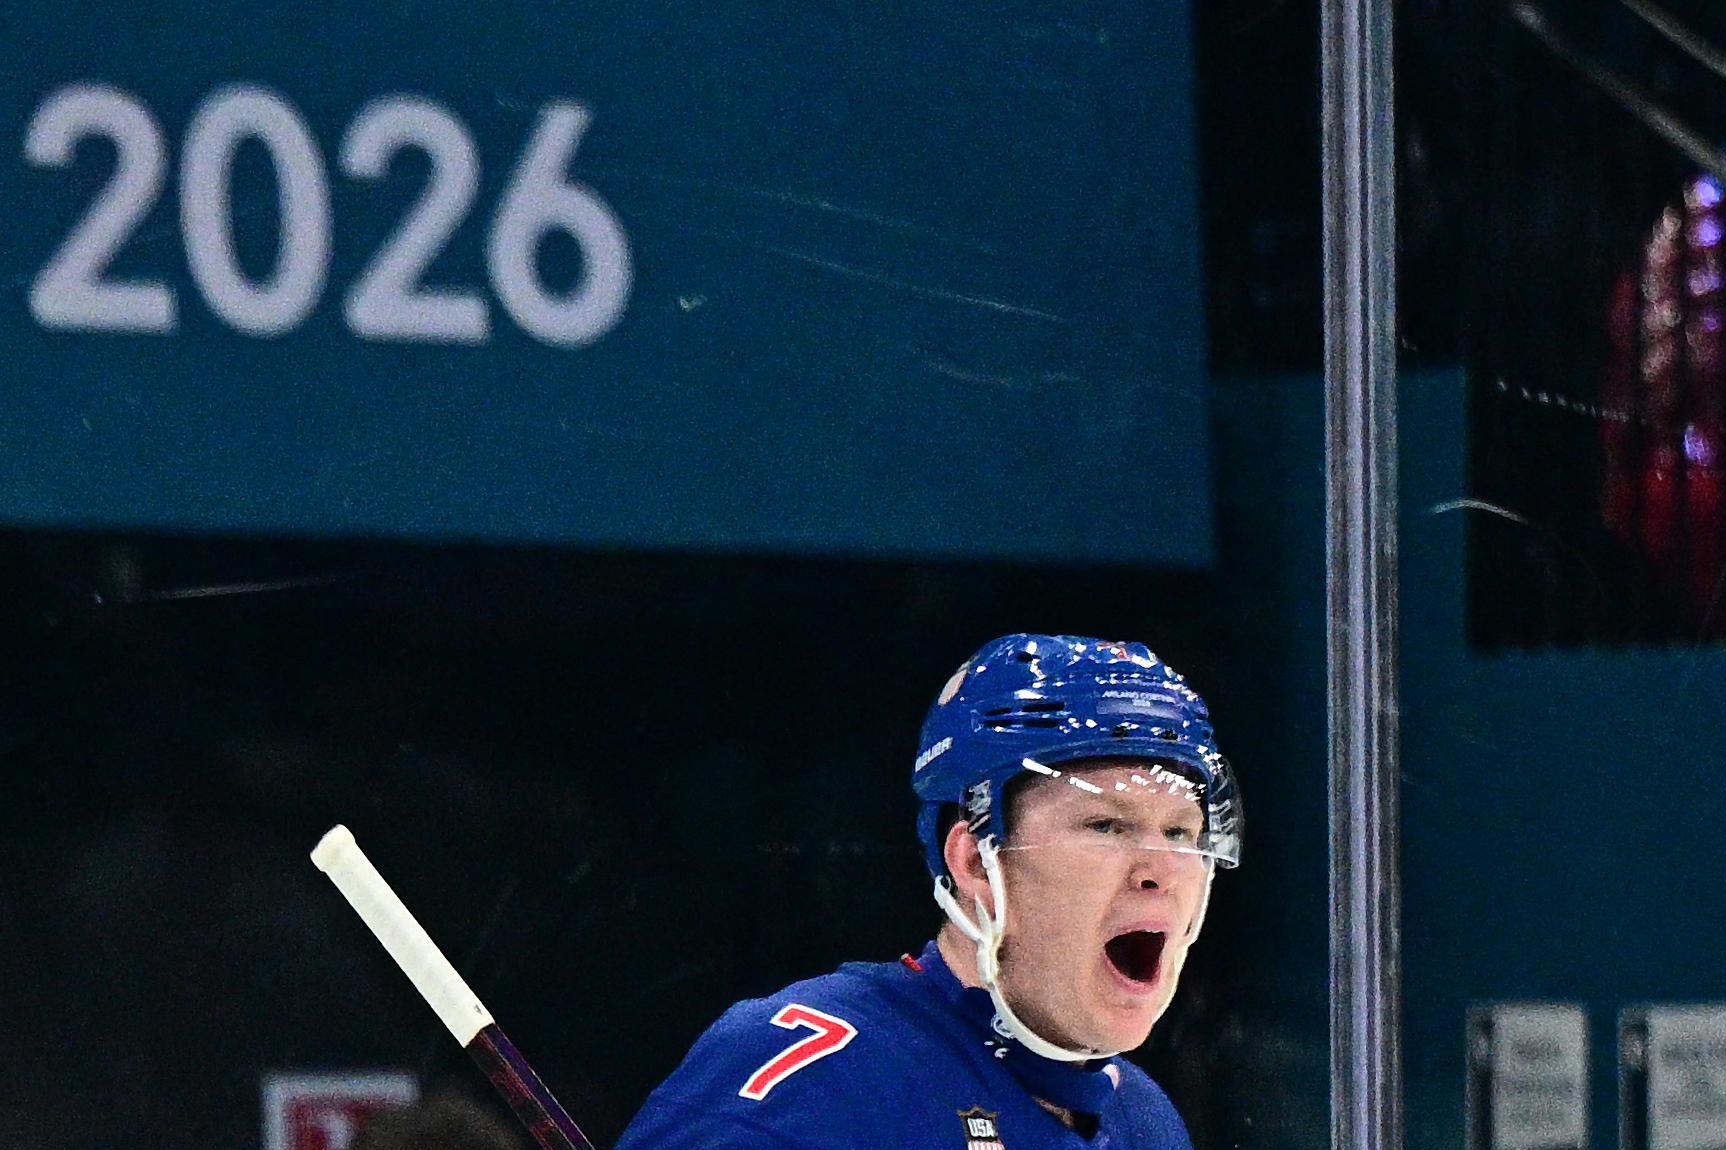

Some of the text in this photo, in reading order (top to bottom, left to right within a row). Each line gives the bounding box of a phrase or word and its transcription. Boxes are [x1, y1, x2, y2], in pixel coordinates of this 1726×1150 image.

[23, 81, 634, 349] 2026
[738, 1003, 859, 1101] 7
[966, 1117, 996, 1139] USA
